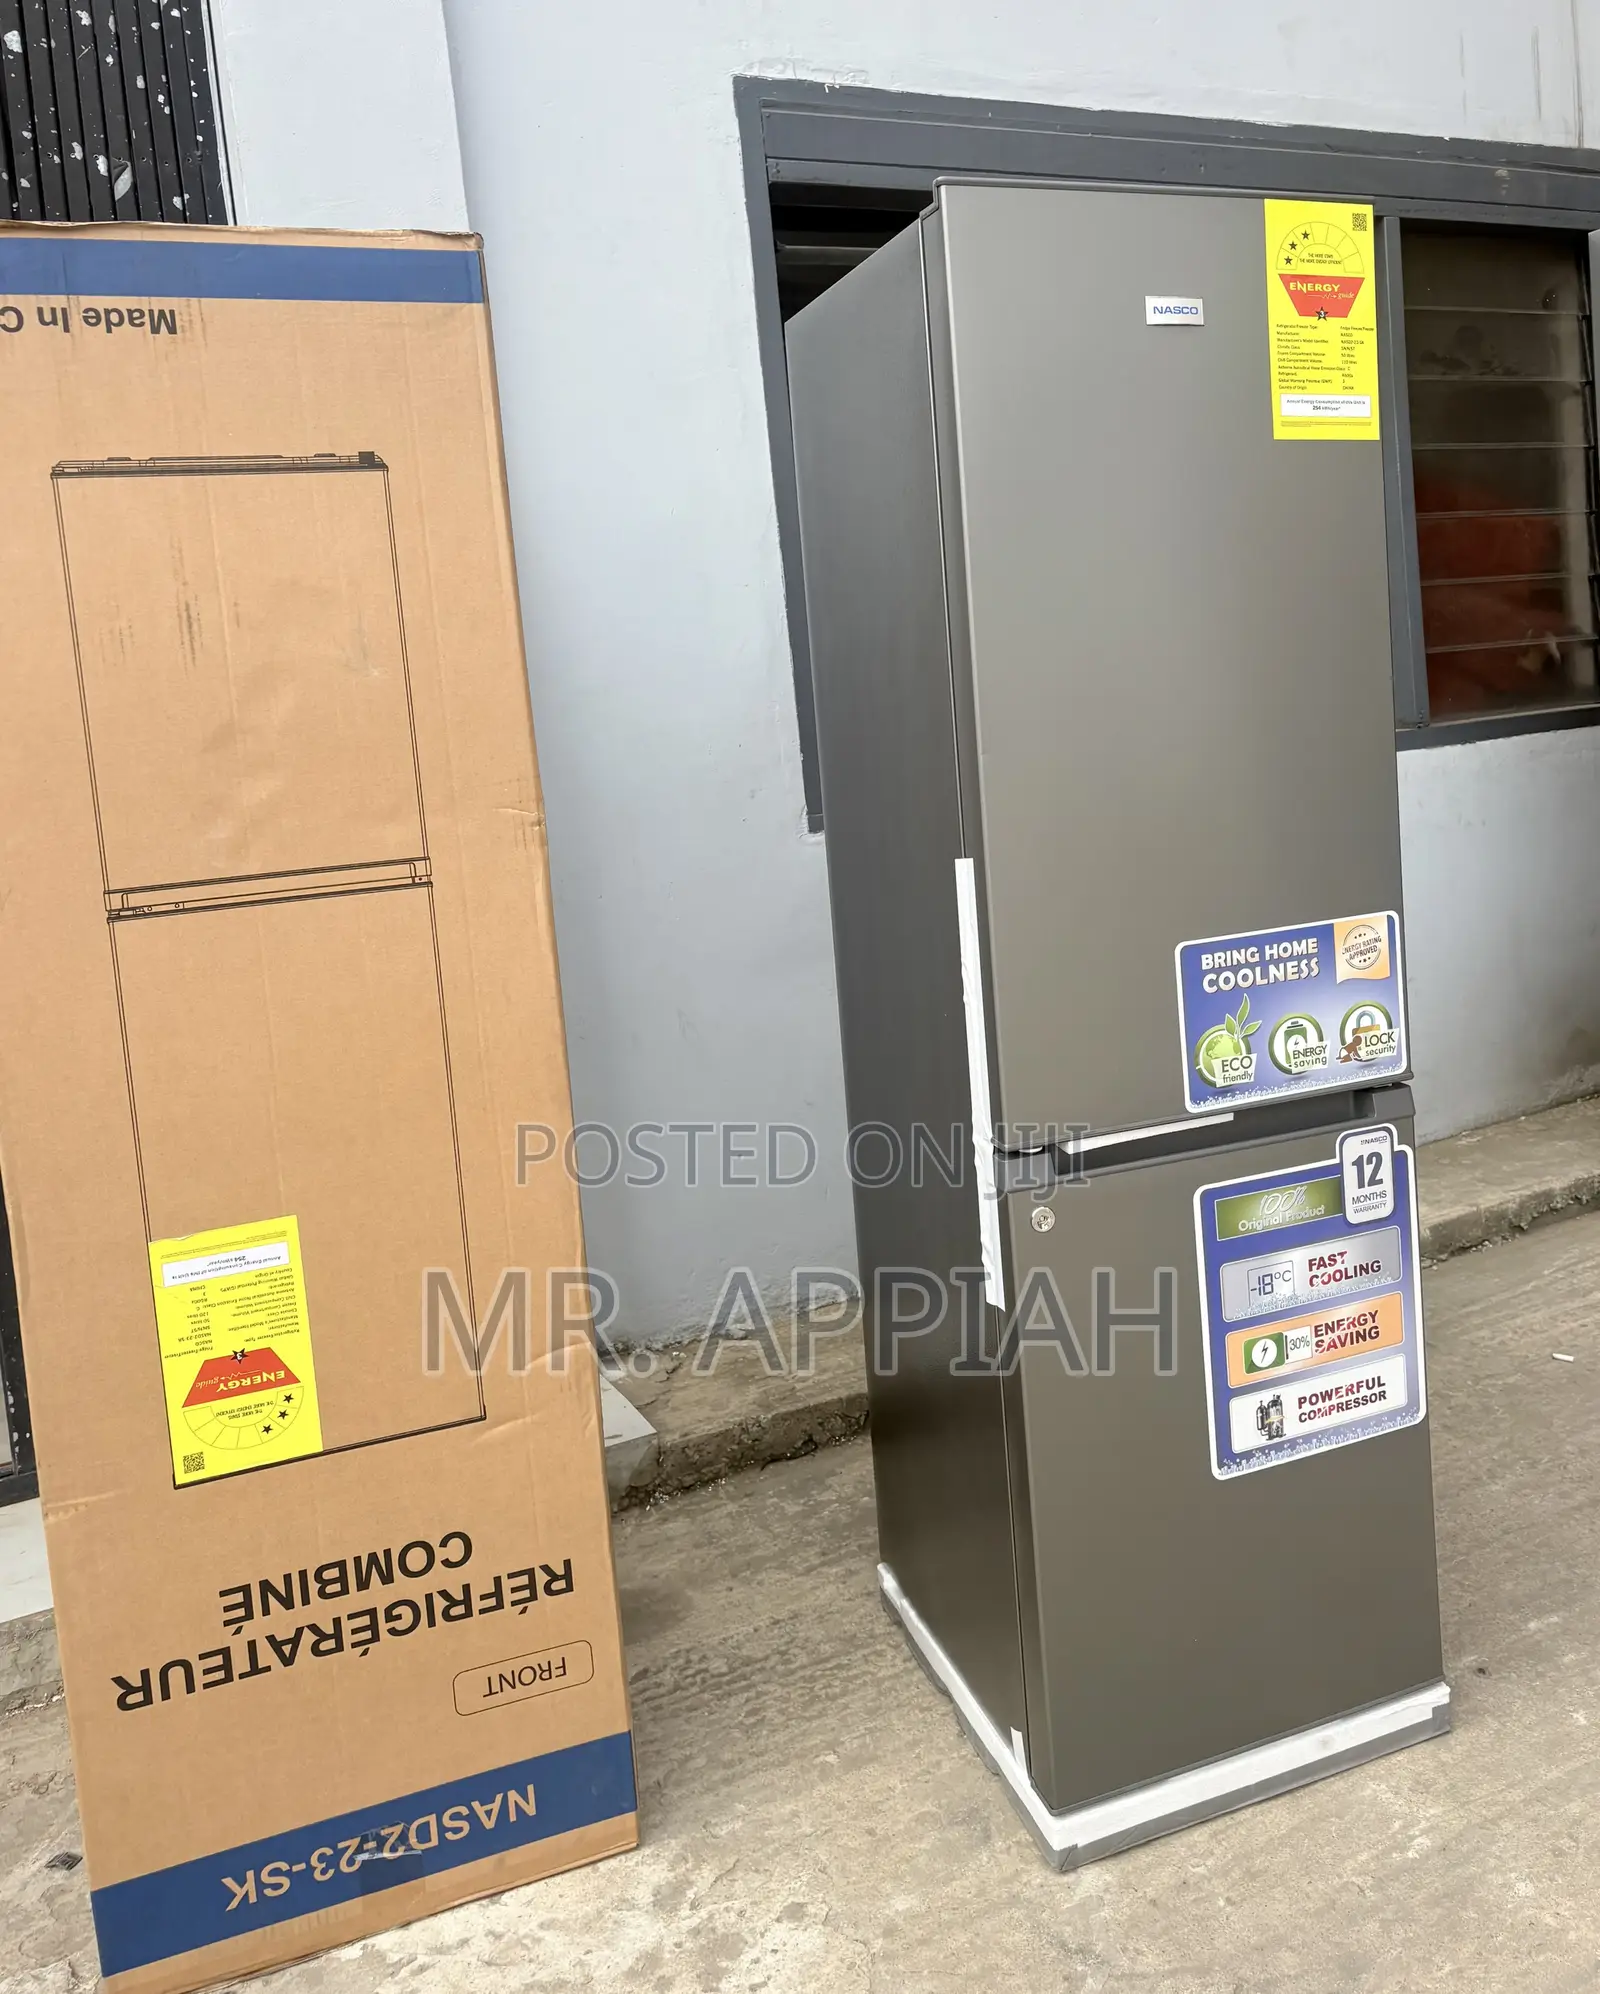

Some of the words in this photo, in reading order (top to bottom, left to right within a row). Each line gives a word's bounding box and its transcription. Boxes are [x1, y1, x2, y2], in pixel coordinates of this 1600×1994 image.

[1289, 280, 1341, 294] ENERGY
[36, 306, 71, 334] In
[81, 307, 179, 336] Made
[1153, 305, 1199, 315] NASCO
[1201, 946, 1260, 971] BRING
[1264, 937, 1319, 962] HOME
[1202, 957, 1320, 994] COOLNESS
[1292, 1043, 1328, 1060] ENERGY
[1364, 1031, 1396, 1048] LOCK
[1365, 1043, 1396, 1057] security
[1221, 1054, 1253, 1073] ECO
[1293, 1055, 1328, 1069] saving
[1222, 1070, 1254, 1084] friendly
[1351, 1151, 1384, 1190] 12
[1259, 1185, 1308, 1216] 100%
[1352, 1189, 1387, 1206] MONTHS
[1353, 1202, 1388, 1214] WARRANTY
[1238, 1211, 1283, 1232] Original
[1285, 1204, 1326, 1222] Product
[1307, 1250, 1349, 1273] FAST
[1308, 1259, 1383, 1289] COOLING
[1313, 1309, 1380, 1339] ENERGY
[1288, 1335, 1311, 1352] 30%
[1314, 1325, 1381, 1355] SAVING
[235, 1352, 242, 1360] 3
[195, 1376, 219, 1389] guide
[216, 1370, 286, 1393] ENERGY
[1297, 1374, 1387, 1409] POWERFUL
[1298, 1390, 1388, 1424] COMPRESSOR
[218, 1531, 474, 1637] COMBINÉ
[110, 1558, 575, 1712] RÉFRIGÉRATEUR
[482, 1656, 567, 1698] FRONT
[220, 1783, 538, 1912] NASD2-23-SK
